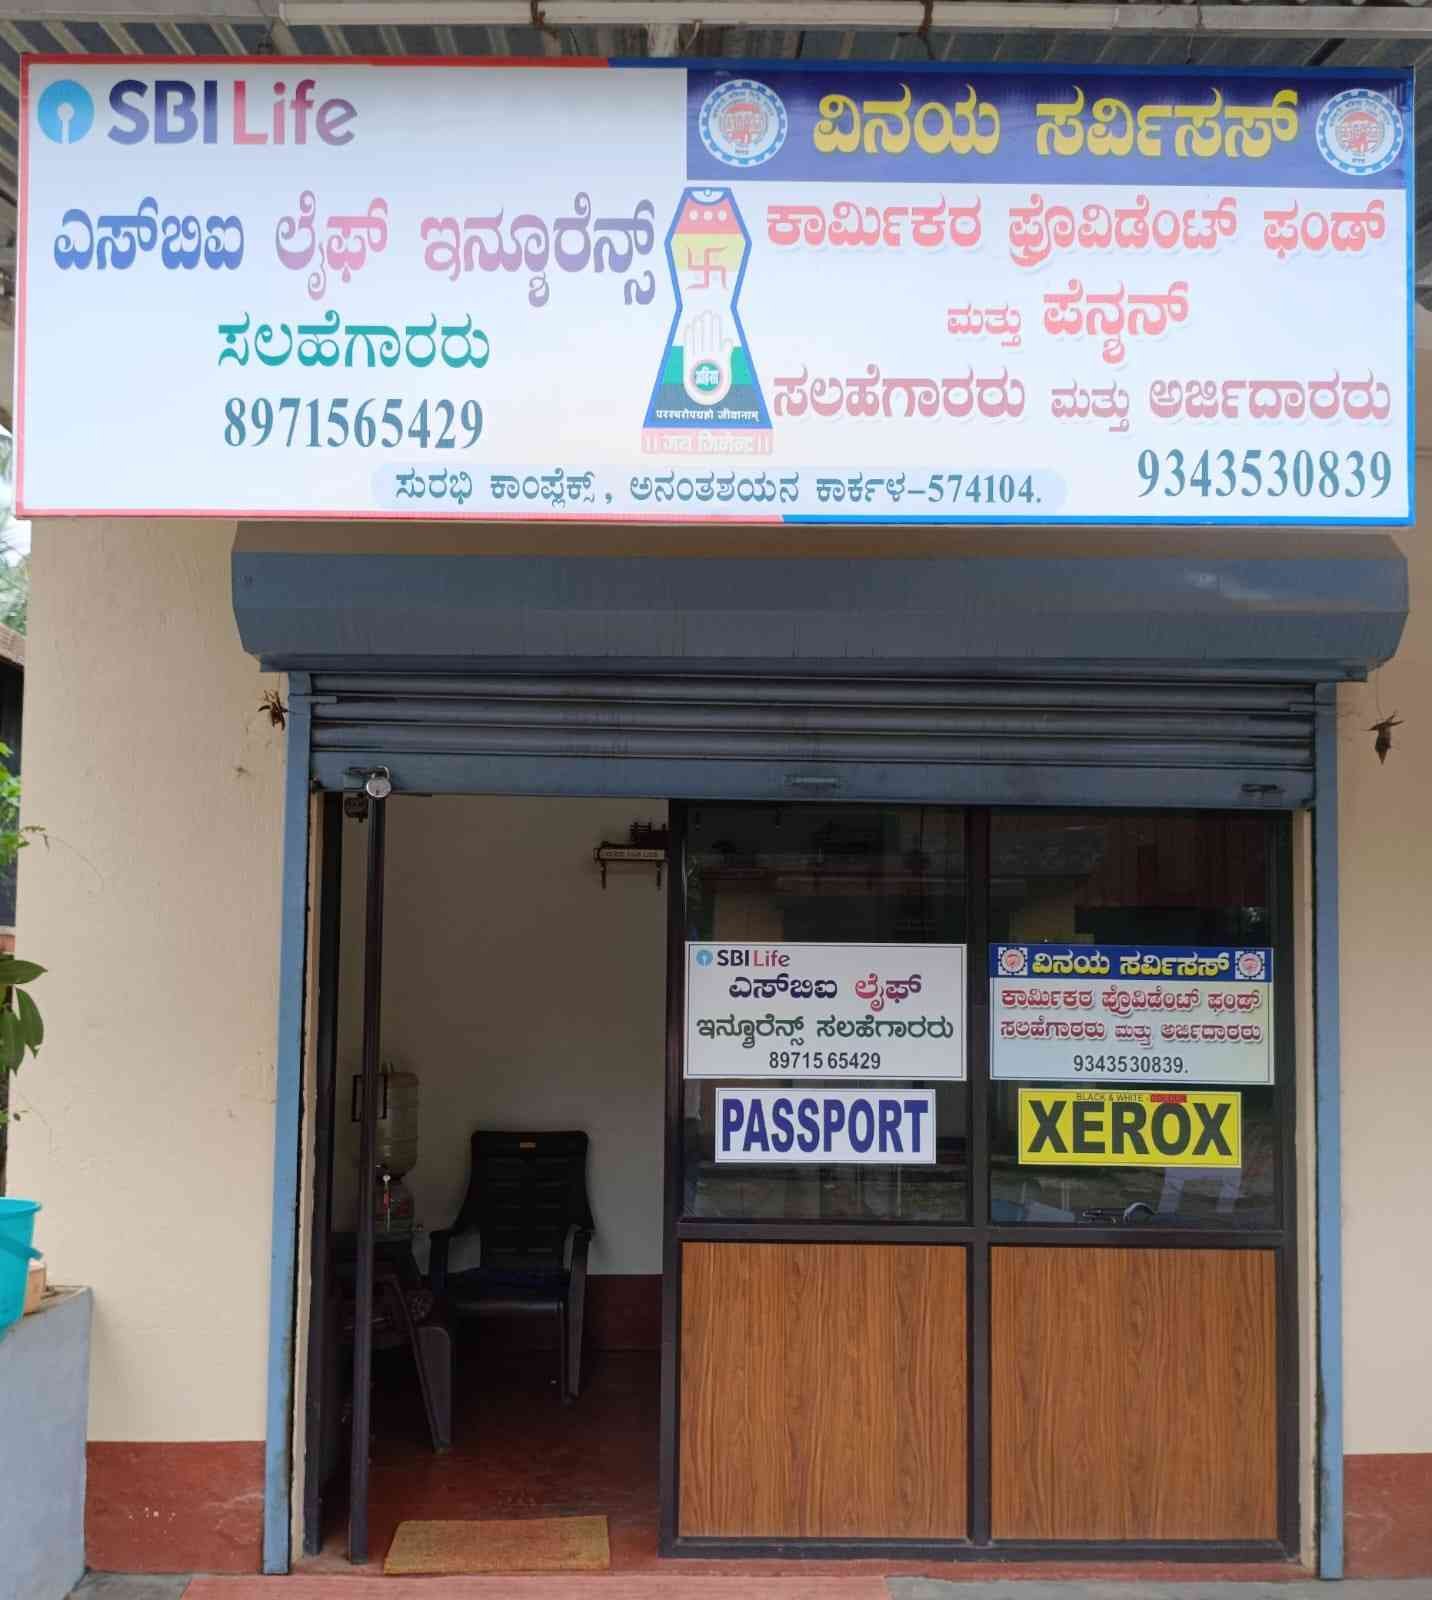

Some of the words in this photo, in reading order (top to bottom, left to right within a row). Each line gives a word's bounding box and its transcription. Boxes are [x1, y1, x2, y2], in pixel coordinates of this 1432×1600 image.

[108, 79, 218, 144] SBI
[233, 79, 357, 145] Life
[814, 84, 1000, 154] ವಿನಯ
[1036, 87, 1298, 159] ಸರ್ವಿಸಸ್
[276, 190, 387, 300] ಲೈಫ್
[420, 191, 656, 307] ಇನ್ಶೂರೆನ್ಸ್
[766, 194, 981, 248] ಕಾರ್ಮಿಕರ
[1263, 199, 1385, 258] ಫಂಡ್
[218, 309, 489, 368] ಸಲಹೆಗಾರರು
[947, 303, 1022, 347] ಮತ್ತು
[774, 364, 1025, 417] ಸಲಹೆಗಾರರು
[1052, 379, 1130, 432] ಮತ್ತು
[1150, 371, 1391, 419] ಅರ್ಜಿದಾರರು
[224, 398, 484, 449] 8971565429
[396, 467, 473, 504] ಸುರಭಿ
[630, 470, 799, 502] ಅನಂತಶಯನ
[1137, 449, 1392, 499] 9343530839
[717, 950, 749, 967] SBI
[753, 950, 790, 967] Life
[1032, 952, 1110, 974] ವಿನಯ
[1119, 952, 1229, 976] ಸರ್ವಿಸಸ್
[855, 973, 922, 1011] ಲೈಫ್
[1001, 987, 1093, 1007] ಕಾರ್ಮಿಕರ
[816, 1014, 954, 1039] ಸಲಹೆಗಾರರು
[1001, 1016, 1105, 1037] ಸಲಹೆಗಾರರು
[1115, 1025, 1151, 1047] ಮತ್ತು
[1073, 1055, 1188, 1074] 9343530839.
[721, 1098, 929, 1154] PASSPORT
[1027, 1101, 1233, 1156] XEROX
